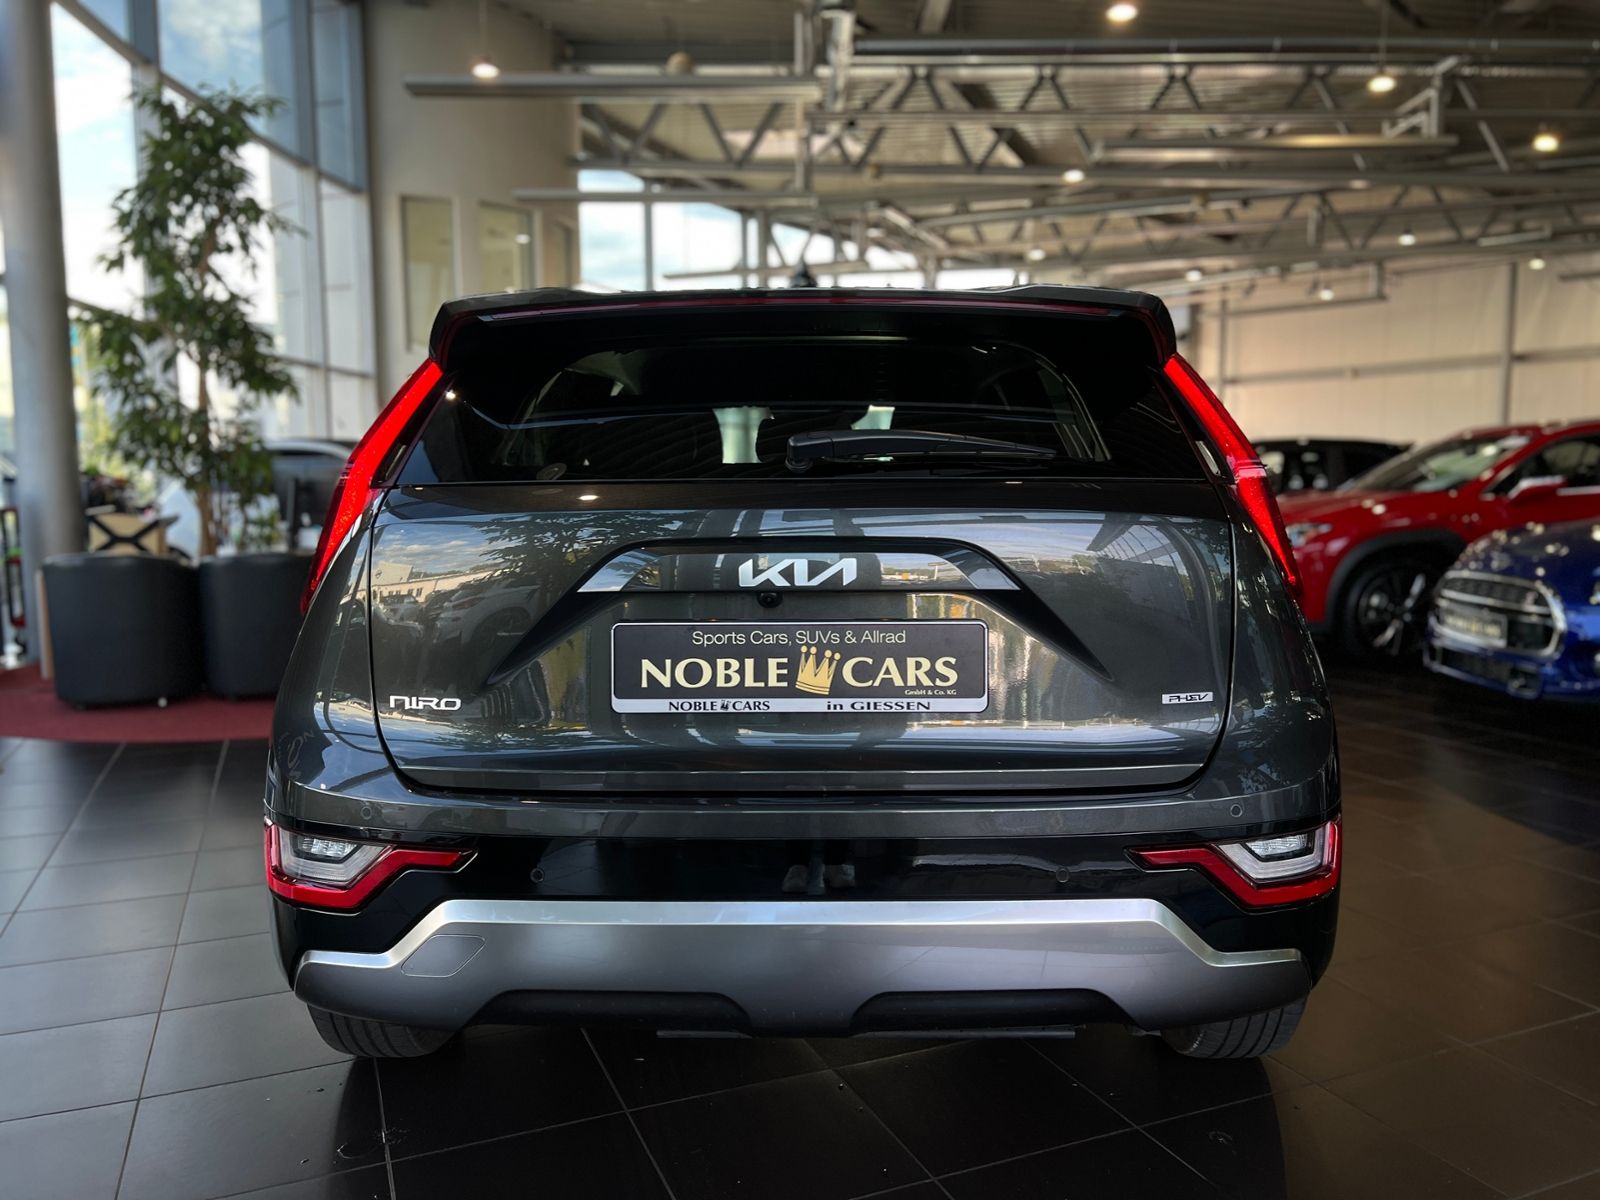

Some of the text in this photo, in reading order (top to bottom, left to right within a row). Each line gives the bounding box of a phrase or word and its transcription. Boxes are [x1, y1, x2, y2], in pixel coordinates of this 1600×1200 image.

[738, 558, 857, 587] KIA
[692, 630, 906, 647] Sports Cars, SUVs & Allrad
[641, 656, 958, 689] NOBLE CARS
[668, 700, 930, 712] NOBLE CARS in GIESSEN
[1168, 693, 1209, 703] PHEV
